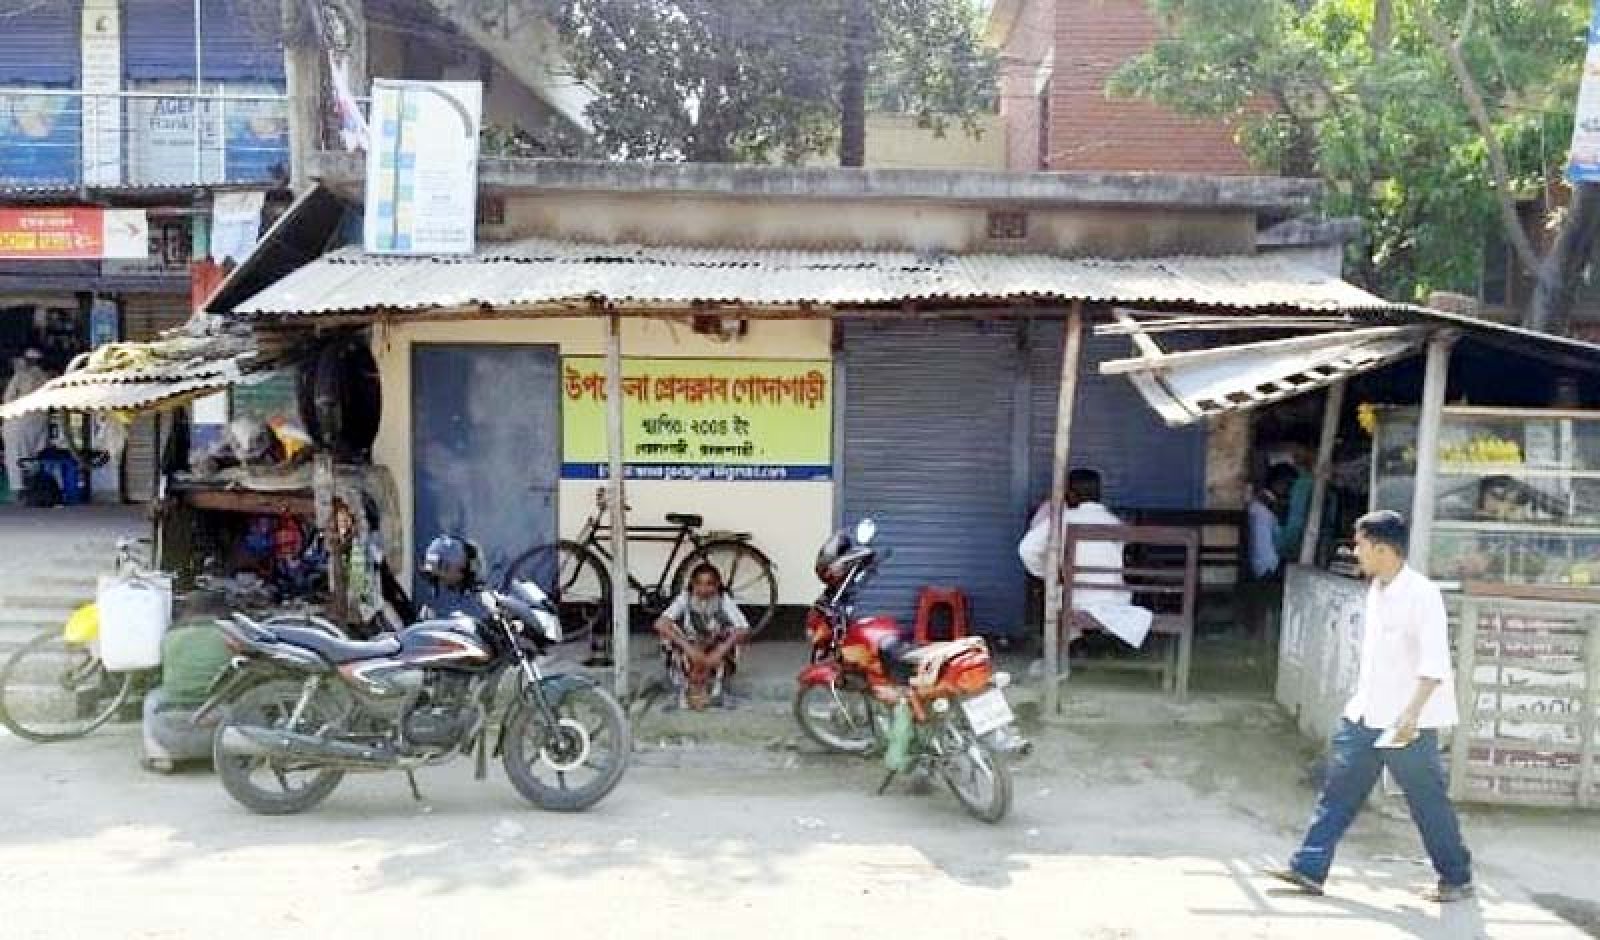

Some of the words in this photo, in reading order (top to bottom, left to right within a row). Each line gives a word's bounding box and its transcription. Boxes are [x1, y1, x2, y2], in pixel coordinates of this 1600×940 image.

[565, 365, 649, 404] উপেলা
[654, 374, 729, 405] প্রেসক্লাব
[732, 369, 827, 410] গোদাগাড়ী
